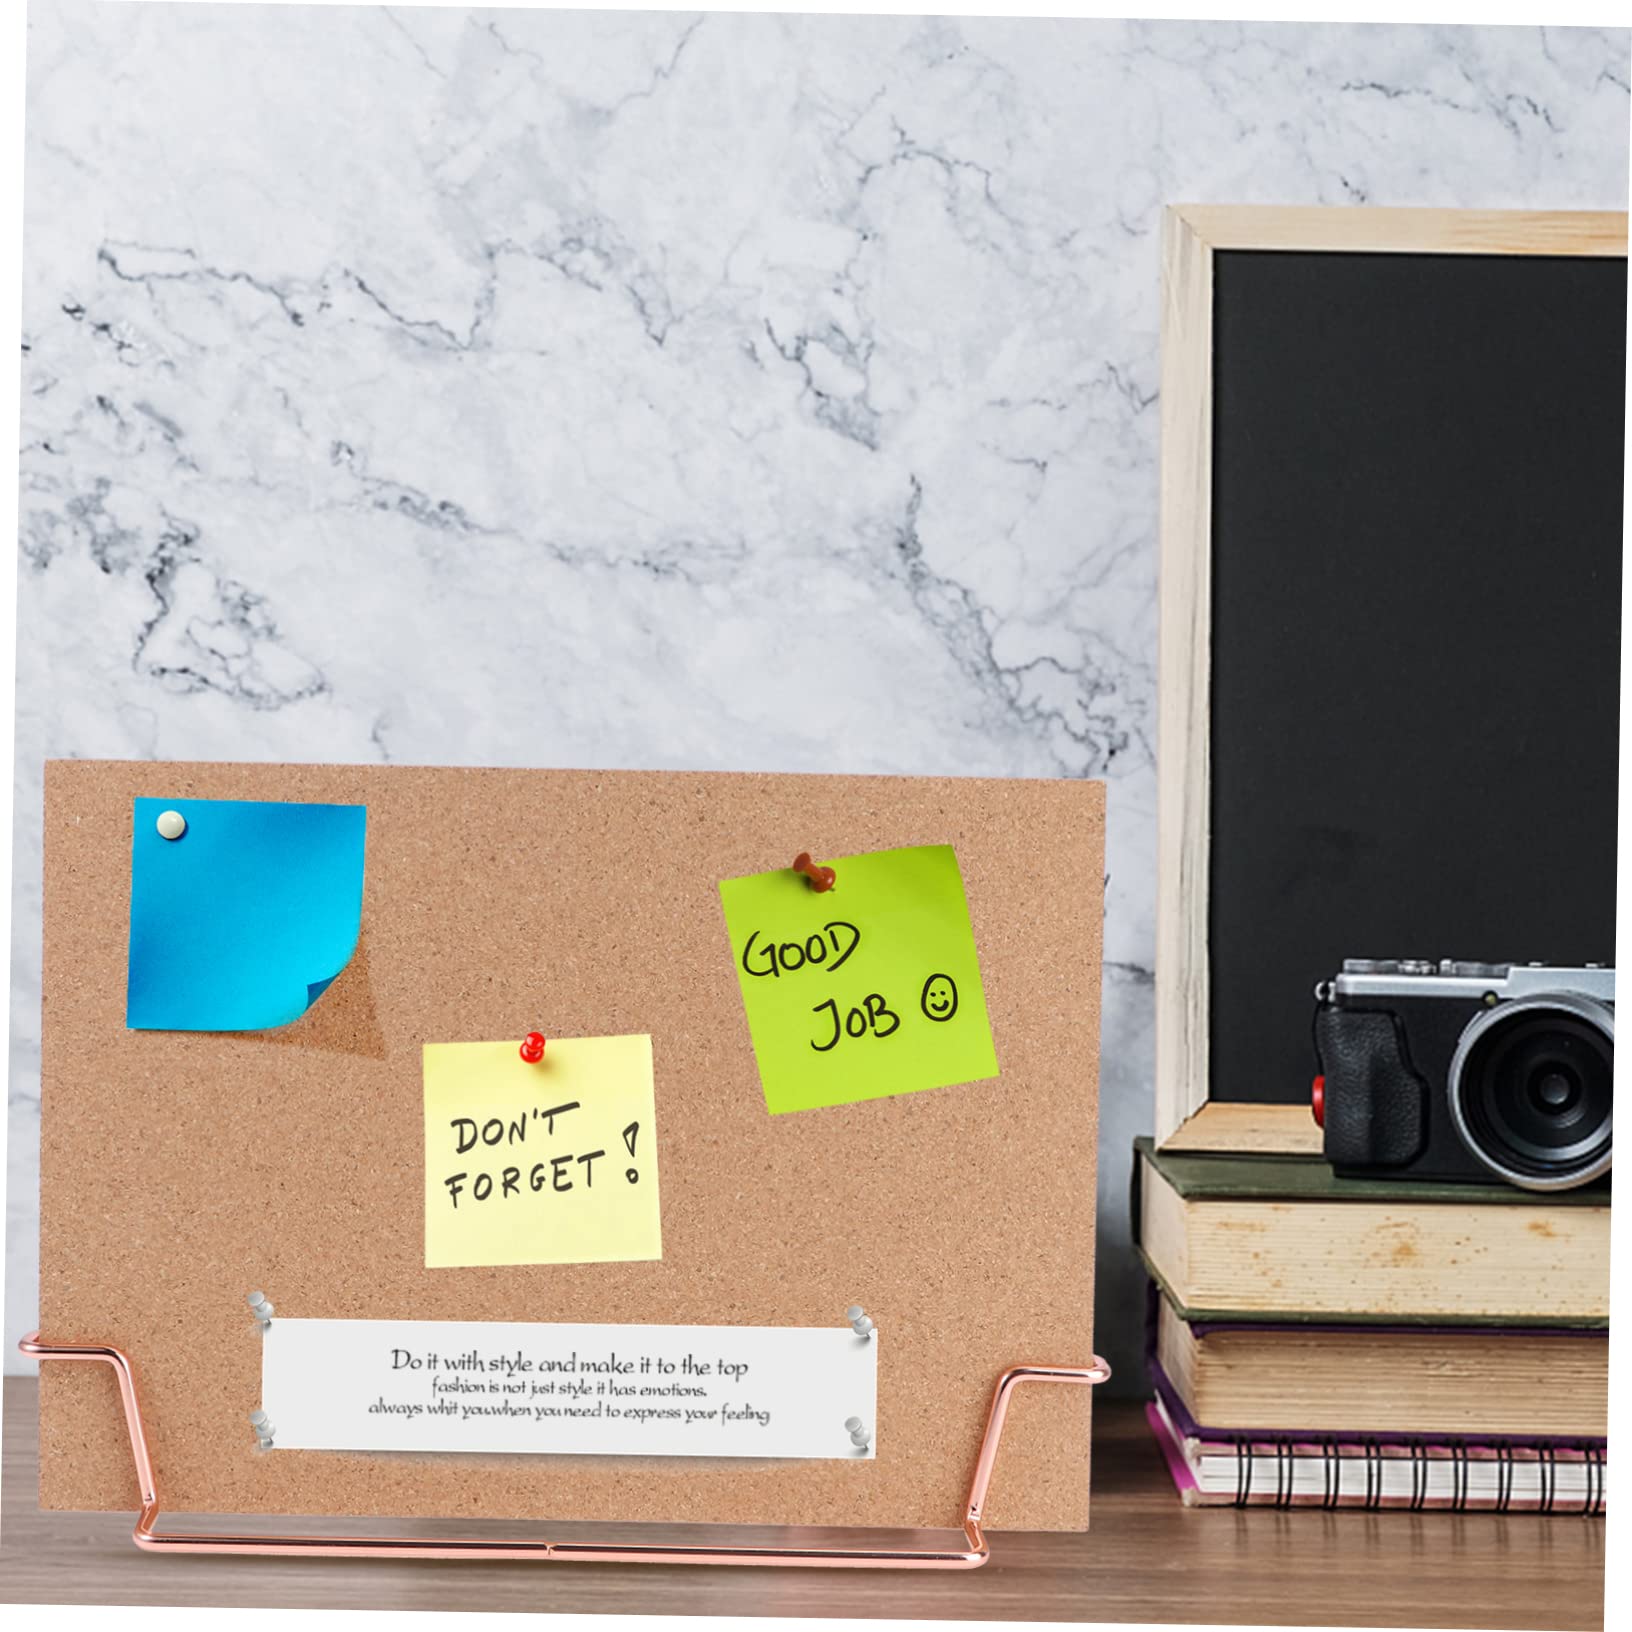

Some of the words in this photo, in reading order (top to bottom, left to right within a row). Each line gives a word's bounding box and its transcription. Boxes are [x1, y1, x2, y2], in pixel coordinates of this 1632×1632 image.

[742, 921, 861, 978] GOOD
[810, 993, 901, 1052] JOB
[450, 1101, 581, 1155] DON'T
[444, 1149, 606, 1209] FORGET
[391, 1348, 423, 1370] Do
[427, 1352, 440, 1370] it
[443, 1349, 486, 1372] with
[488, 1350, 534, 1378] style
[538, 1351, 577, 1373] and
[579, 1352, 636, 1374] make
[640, 1355, 653, 1374] it
[656, 1356, 676, 1375] to
[680, 1353, 712, 1376] the
[716, 1357, 750, 1383] top
[431, 1374, 486, 1399] fashion
[488, 1378, 501, 1394] is
[502, 1380, 527, 1394] not
[529, 1379, 556, 1400] just
[557, 1377, 595, 1400] style
[596, 1380, 607, 1396] it
[608, 1378, 638, 1397] has
[639, 1381, 708, 1397] emotions.
[367, 1396, 424, 1420] always
[426, 1397, 459, 1417] whit
[534, 1405, 562, 1422] you
[563, 1400, 603, 1418] need
[604, 1403, 622, 1419] to
[623, 1407, 682, 1425] express
[684, 1408, 718, 1425] your
[721, 1401, 772, 1428] feeling
